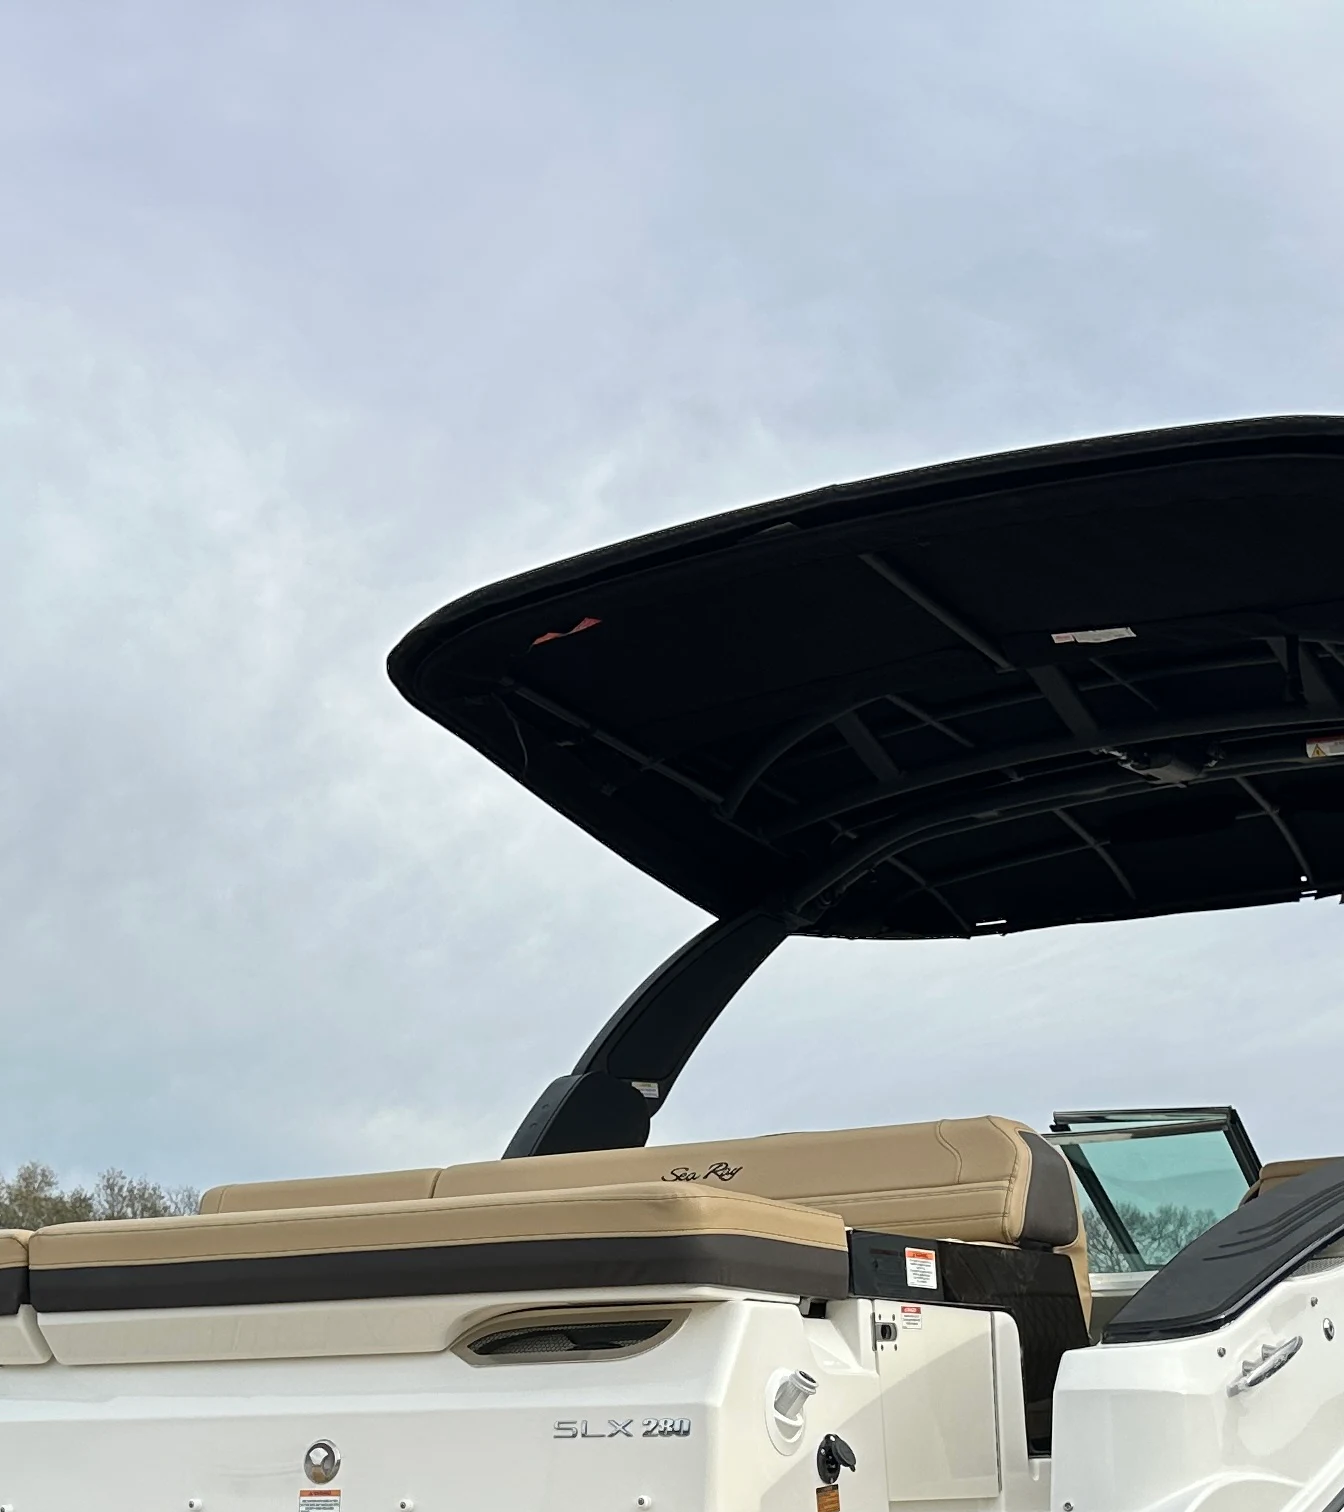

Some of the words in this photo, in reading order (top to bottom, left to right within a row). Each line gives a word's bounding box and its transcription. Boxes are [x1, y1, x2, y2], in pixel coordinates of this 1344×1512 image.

[661, 1167, 701, 1181] Sea
[703, 1162, 743, 1181] Ray
[553, 1419, 634, 1439] SLX
[642, 1418, 692, 1438] 280
